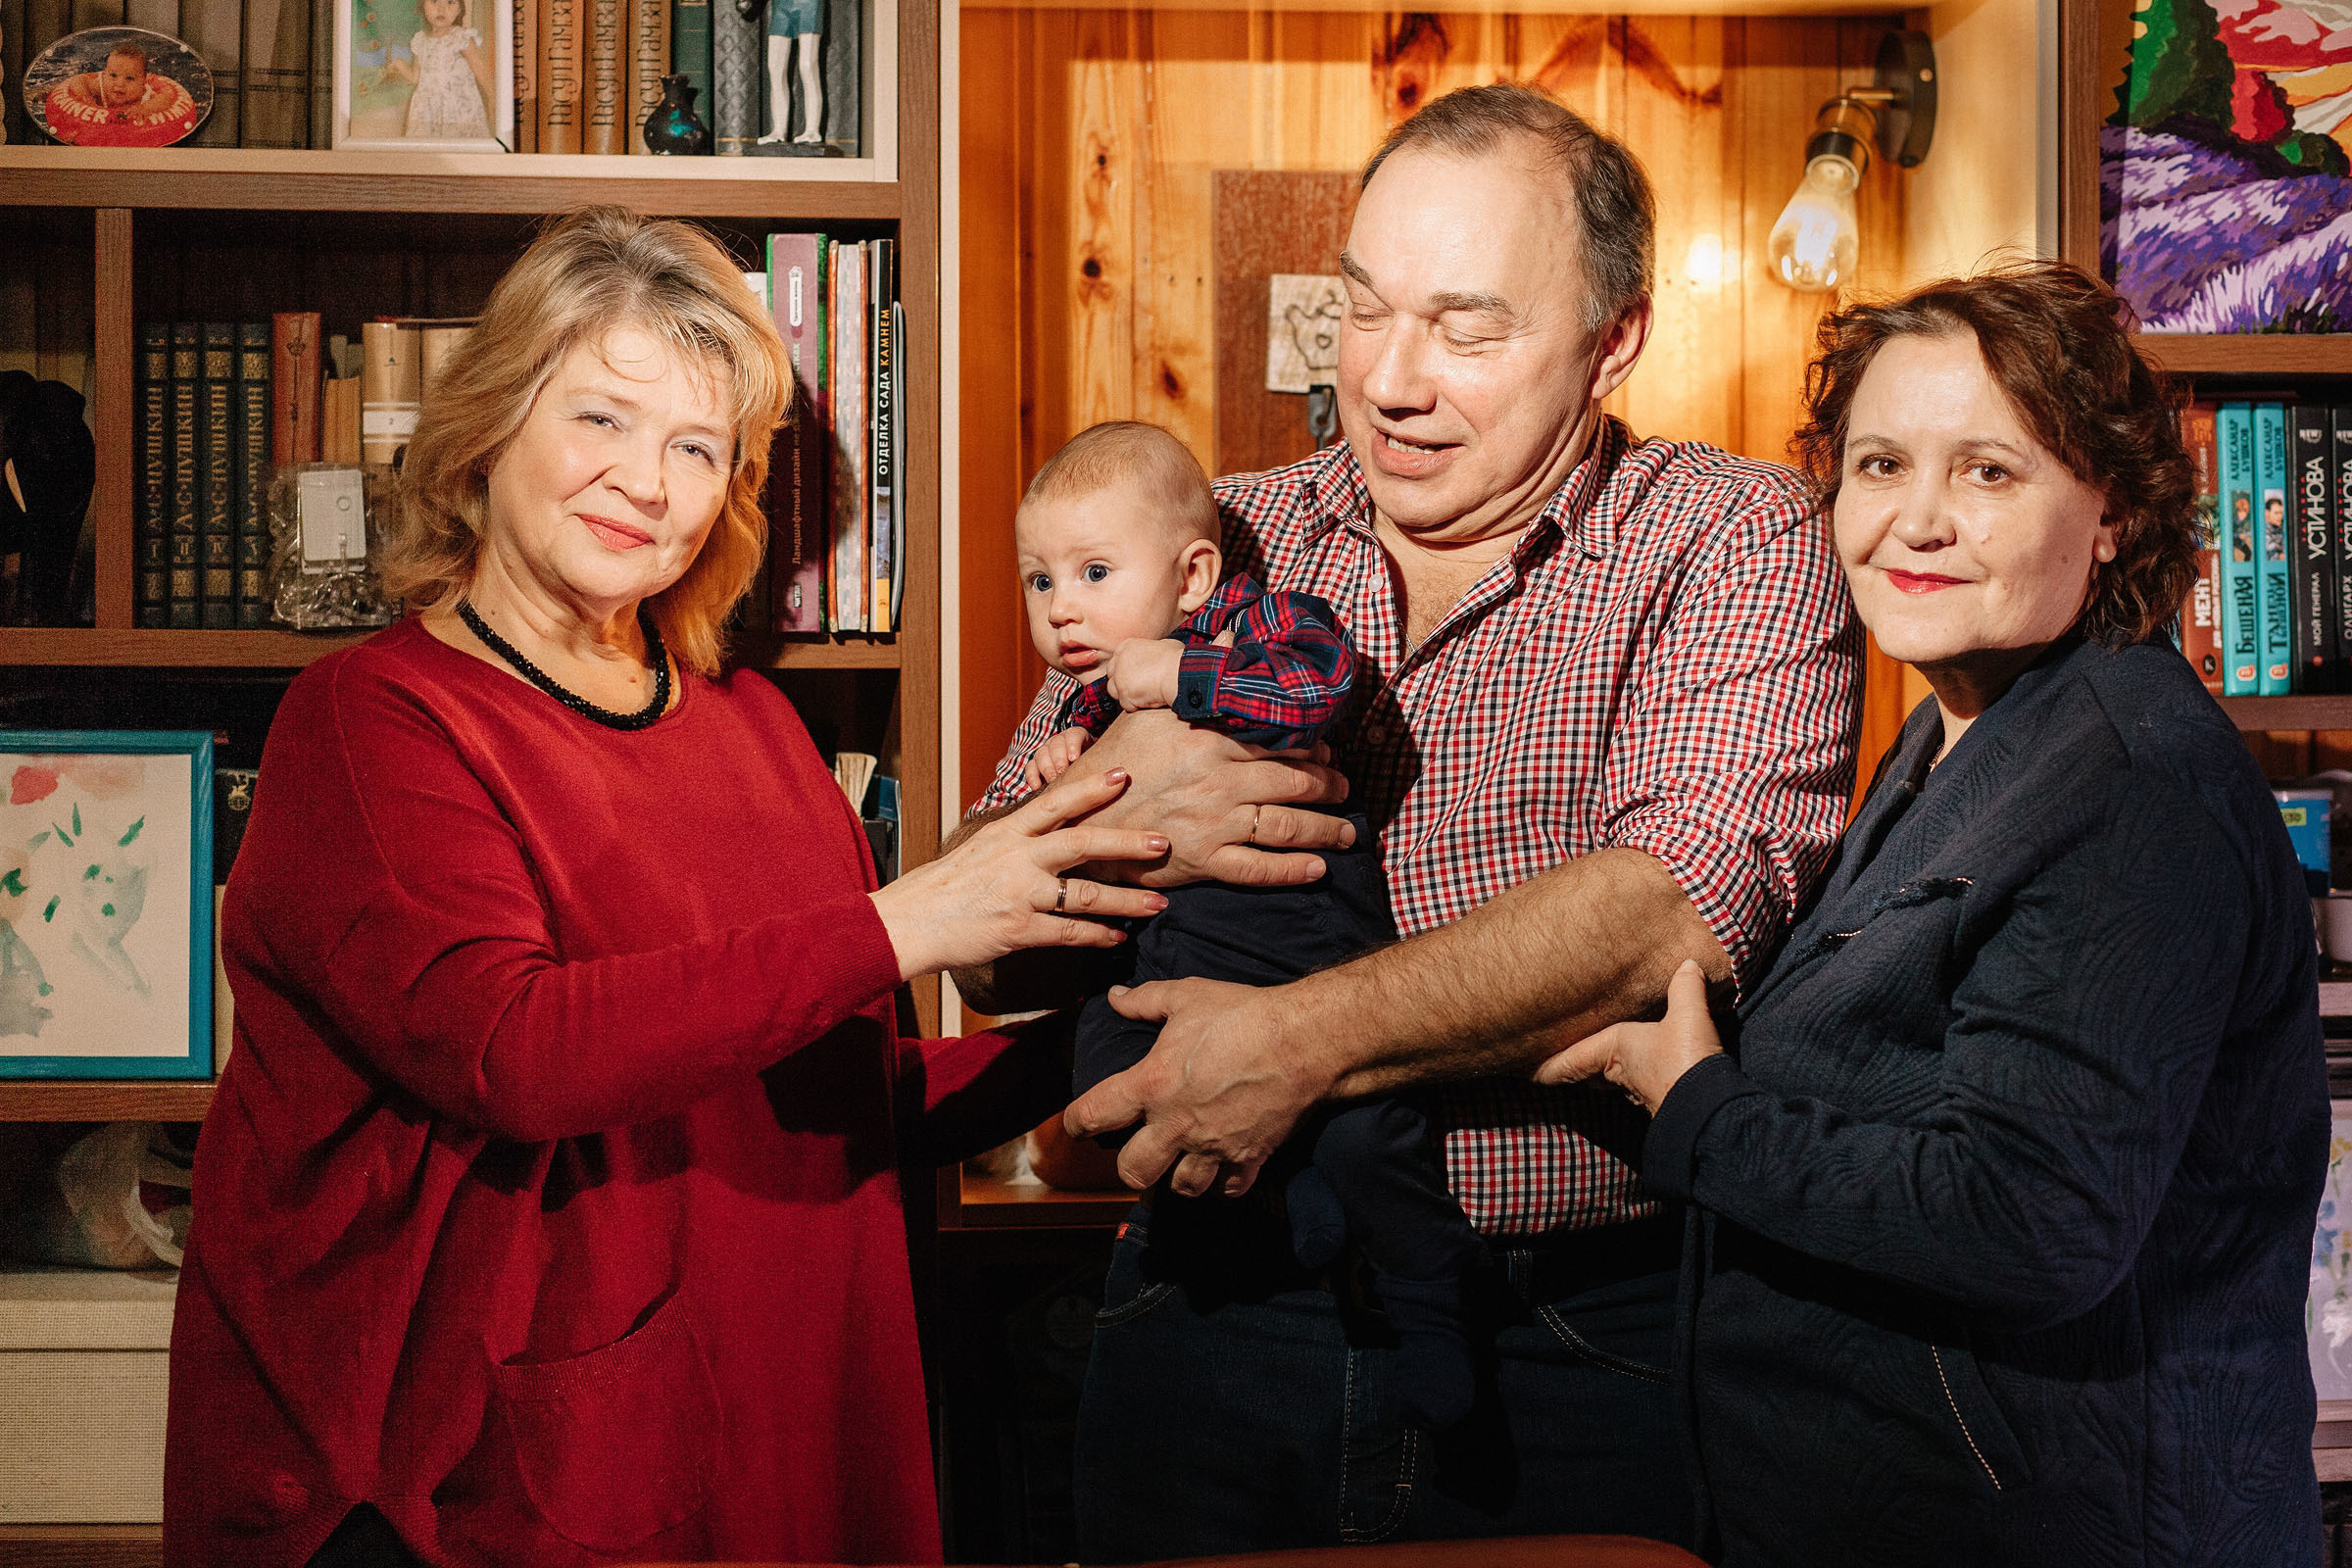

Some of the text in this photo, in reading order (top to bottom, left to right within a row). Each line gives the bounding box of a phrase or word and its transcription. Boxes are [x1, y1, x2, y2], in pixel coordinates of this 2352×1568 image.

[878, 309, 891, 475] ОТДЕЛКА САДА КАМНЕМ
[793, 448, 803, 487] дизайн
[792, 488, 803, 564] Ландшафтный
[2305, 456, 2328, 561] УСТИНОВА
[2193, 578, 2212, 627] МЕНТ
[2311, 571, 2322, 647] МОЙ ГЕНЕРАЛ
[2342, 574, 2352, 640] ОЛИГАРХ
